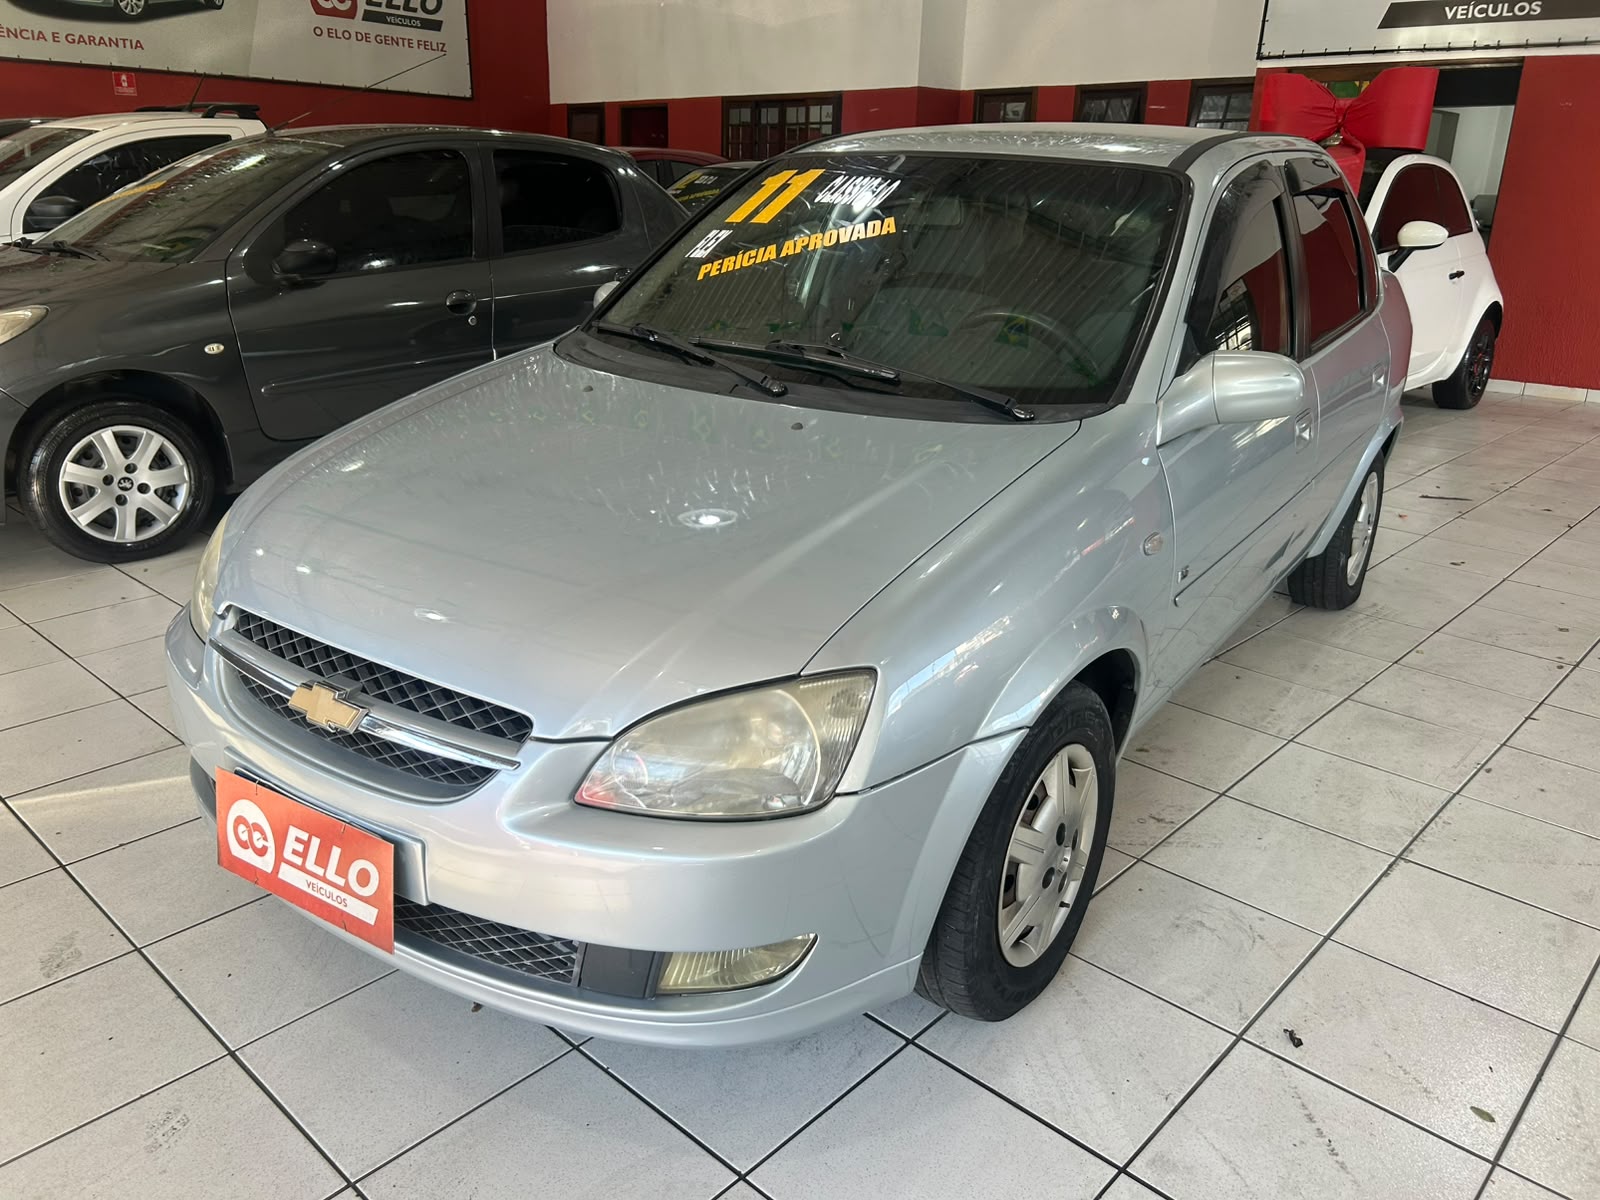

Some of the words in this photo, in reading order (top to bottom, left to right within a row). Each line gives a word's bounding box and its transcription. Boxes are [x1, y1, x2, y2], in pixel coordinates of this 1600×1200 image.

[1444, 1, 1543, 19] VEÍCULOS
[51, 32, 60, 43] E
[65, 33, 145, 50] GARANTIA
[313, 26, 323, 37] O
[327, 28, 352, 41] ELO
[355, 31, 371, 43] DE
[375, 34, 414, 49] GENTE
[417, 40, 447, 53] FELIZ
[725, 169, 826, 224] 11
[684, 229, 734, 258] FLEX
[697, 244, 776, 281] PERÍCIA
[780, 216, 897, 258] APROVADA
[282, 825, 380, 897] ELLO
[306, 879, 348, 908] VEÍCULOS
